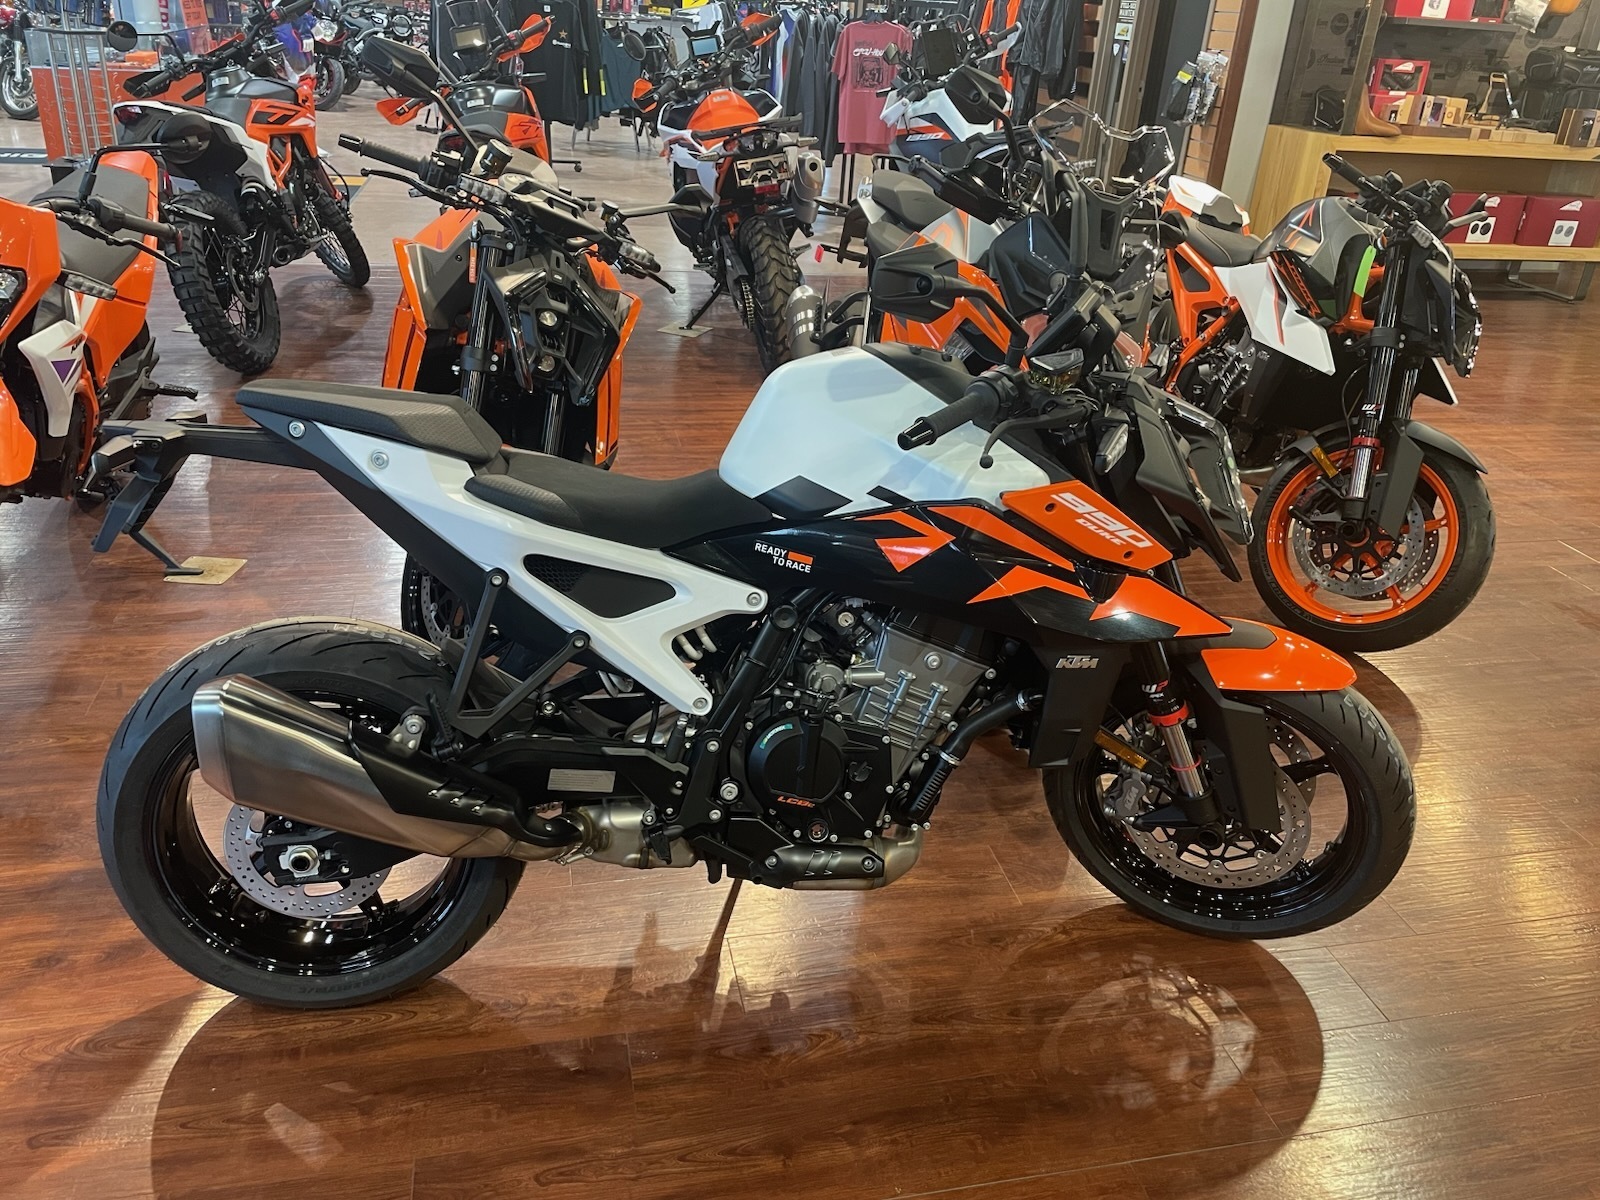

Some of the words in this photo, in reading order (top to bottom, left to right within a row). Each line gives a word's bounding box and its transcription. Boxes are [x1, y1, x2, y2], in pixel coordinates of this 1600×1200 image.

[1050, 492, 1154, 548] 990
[1075, 518, 1126, 545] DUKE
[754, 542, 787, 558] READY
[772, 556, 785, 567] TO
[785, 559, 812, 574] RACE
[1055, 654, 1099, 669] KTM
[1141, 679, 1169, 693] WP
